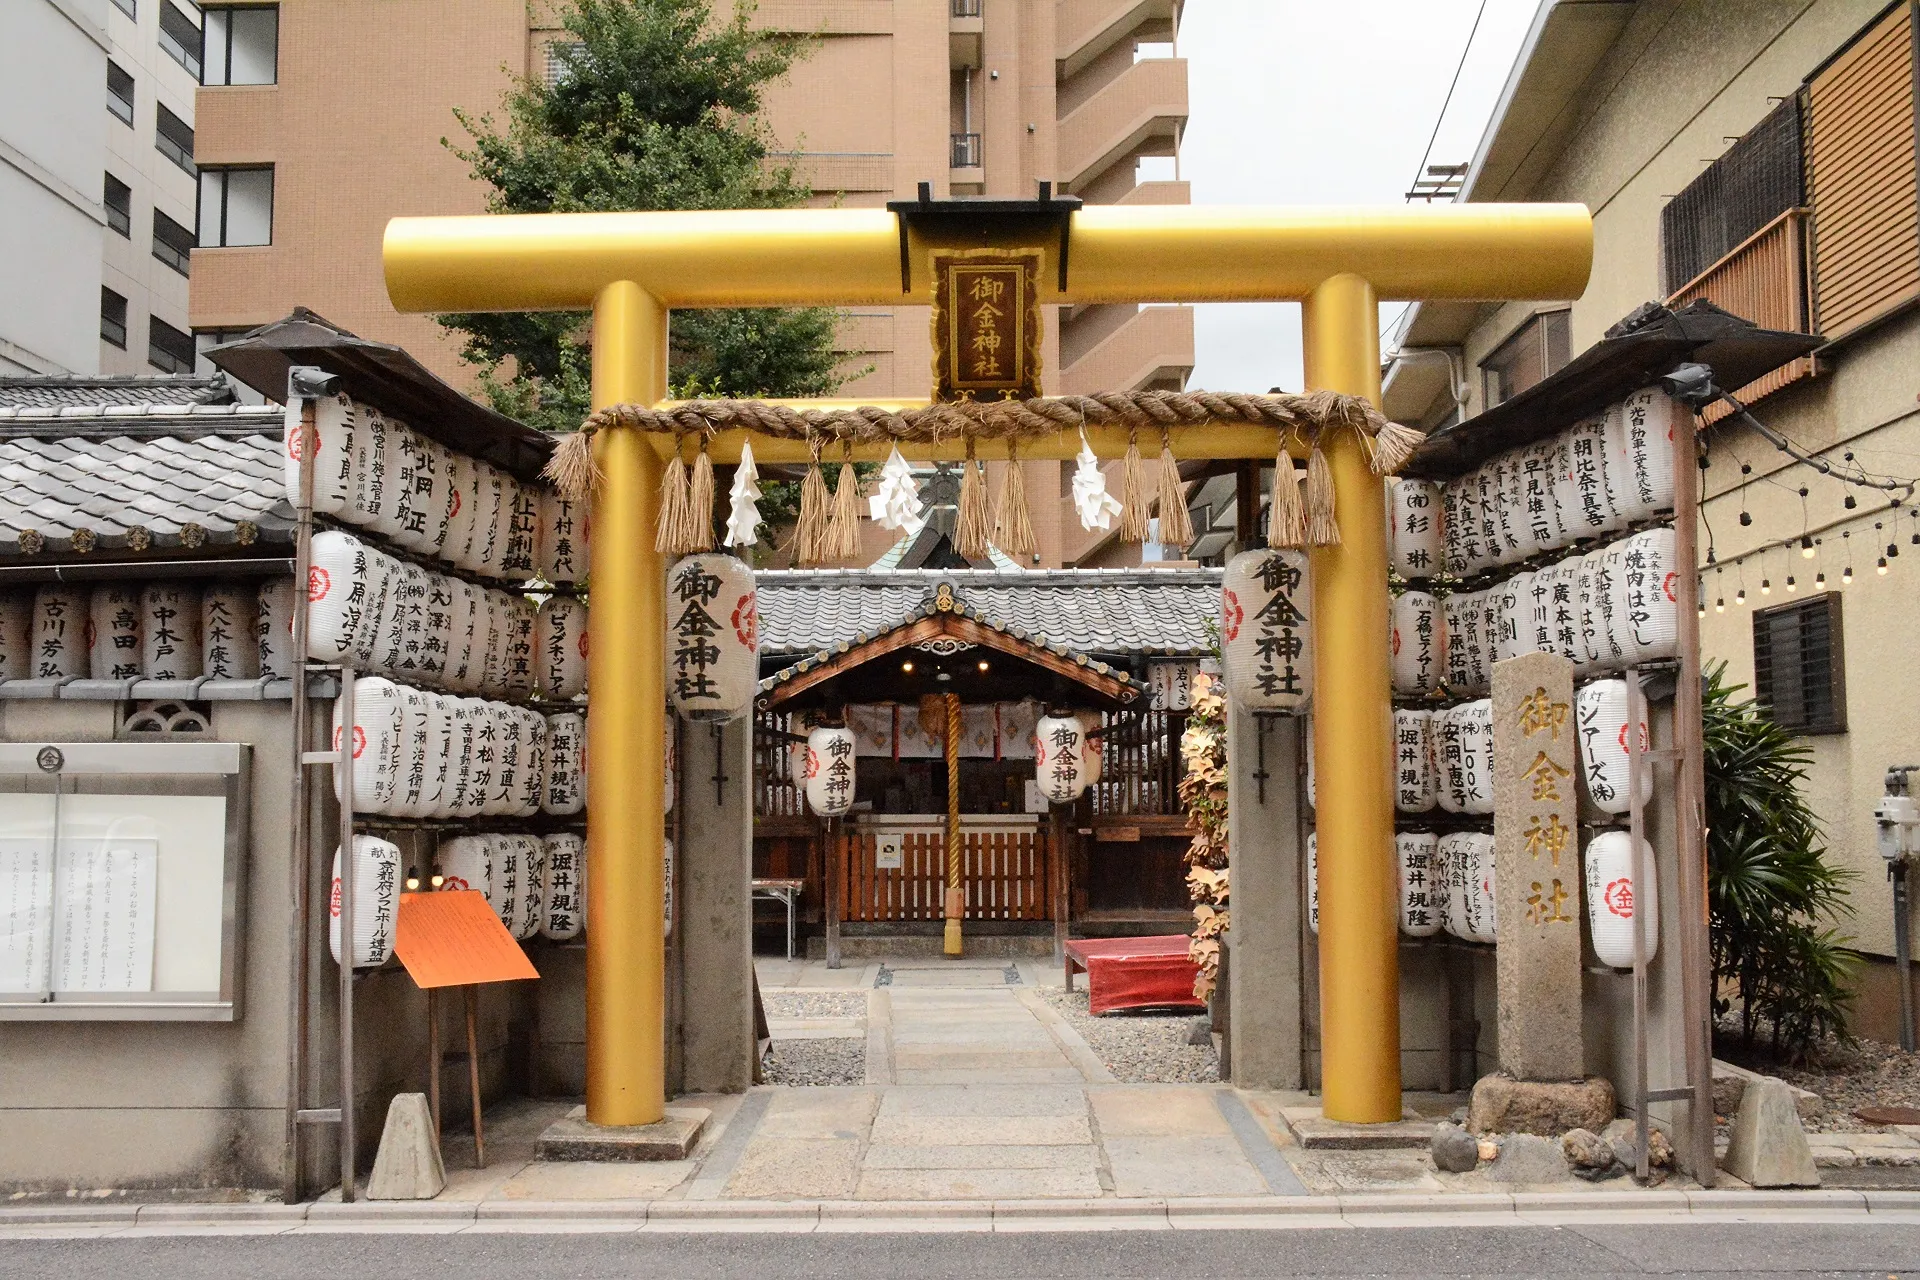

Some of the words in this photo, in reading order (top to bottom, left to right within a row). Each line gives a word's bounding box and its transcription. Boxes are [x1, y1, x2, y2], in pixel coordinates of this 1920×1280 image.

[969, 275, 1004, 377] 御金神社
[1573, 438, 1607, 527] 朝比奈真吾
[39, 598, 67, 678] 古川芳弘
[672, 561, 724, 701] 御金神社
[1250, 554, 1308, 697] 御金神社
[1624, 548, 1655, 646] 焼肉はやし
[824, 733, 852, 812] 御金神社
[1050, 724, 1079, 800] 御金神社
[1399, 729, 1421, 805] 堀井規隆
[1517, 686, 1573, 926] 御金神社
[550, 853, 574, 931] 堀井規隆
[1406, 853, 1431, 926] 堀井規隆
